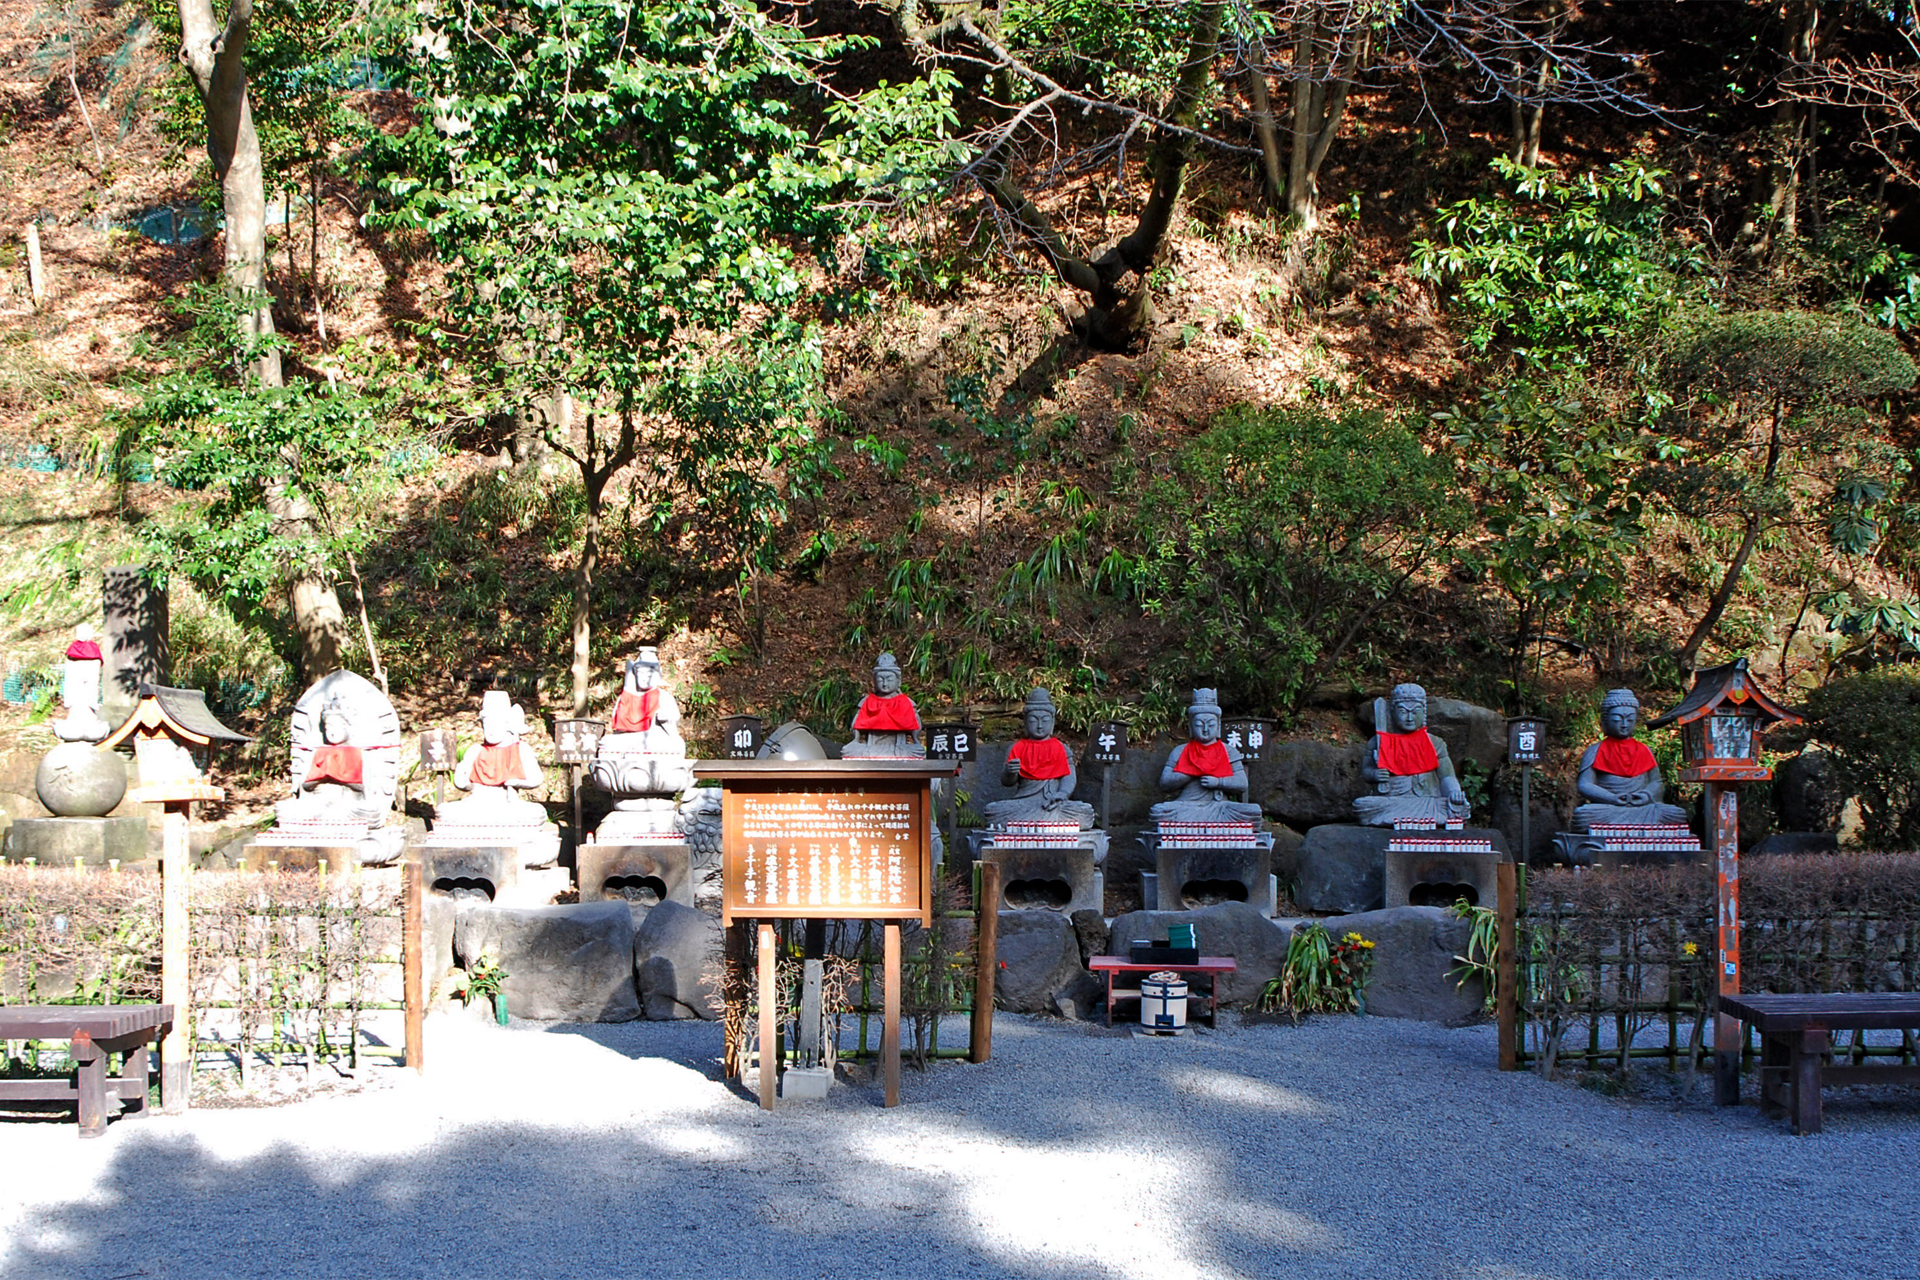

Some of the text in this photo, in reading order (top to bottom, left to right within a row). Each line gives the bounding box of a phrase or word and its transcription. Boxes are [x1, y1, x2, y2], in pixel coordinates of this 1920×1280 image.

[734, 729, 752, 749] 卯
[931, 733, 970, 752] 辰巳
[1098, 732, 1117, 752] 午
[1226, 730, 1263, 749] 未申
[1518, 731, 1537, 751] 酉
